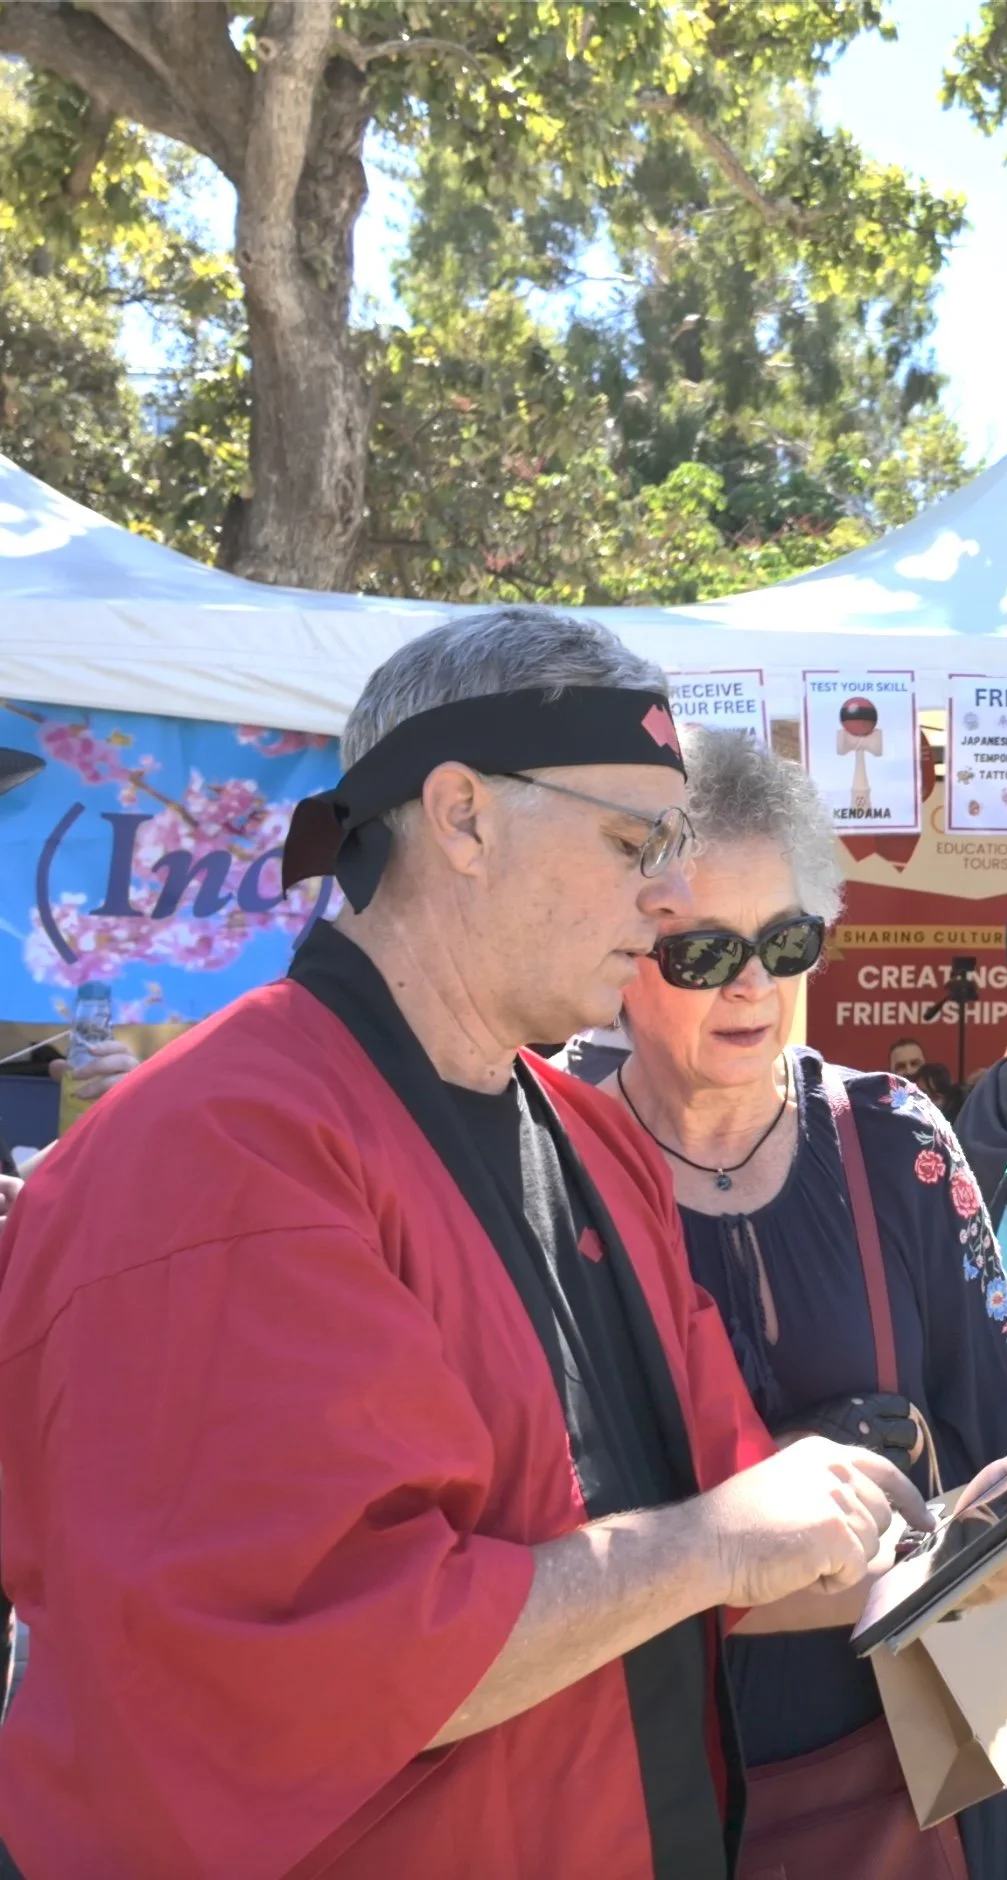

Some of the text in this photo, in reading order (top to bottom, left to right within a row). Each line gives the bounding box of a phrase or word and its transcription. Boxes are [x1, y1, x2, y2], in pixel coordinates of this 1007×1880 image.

[671, 683, 744, 699] RECEIVE
[810, 682, 909, 692] TEST YOUR SKILL
[671, 699, 757, 717] OUR FREE
[833, 807, 892, 820] KENDAMA
[844, 930, 1003, 944] SHARING CULTUR
